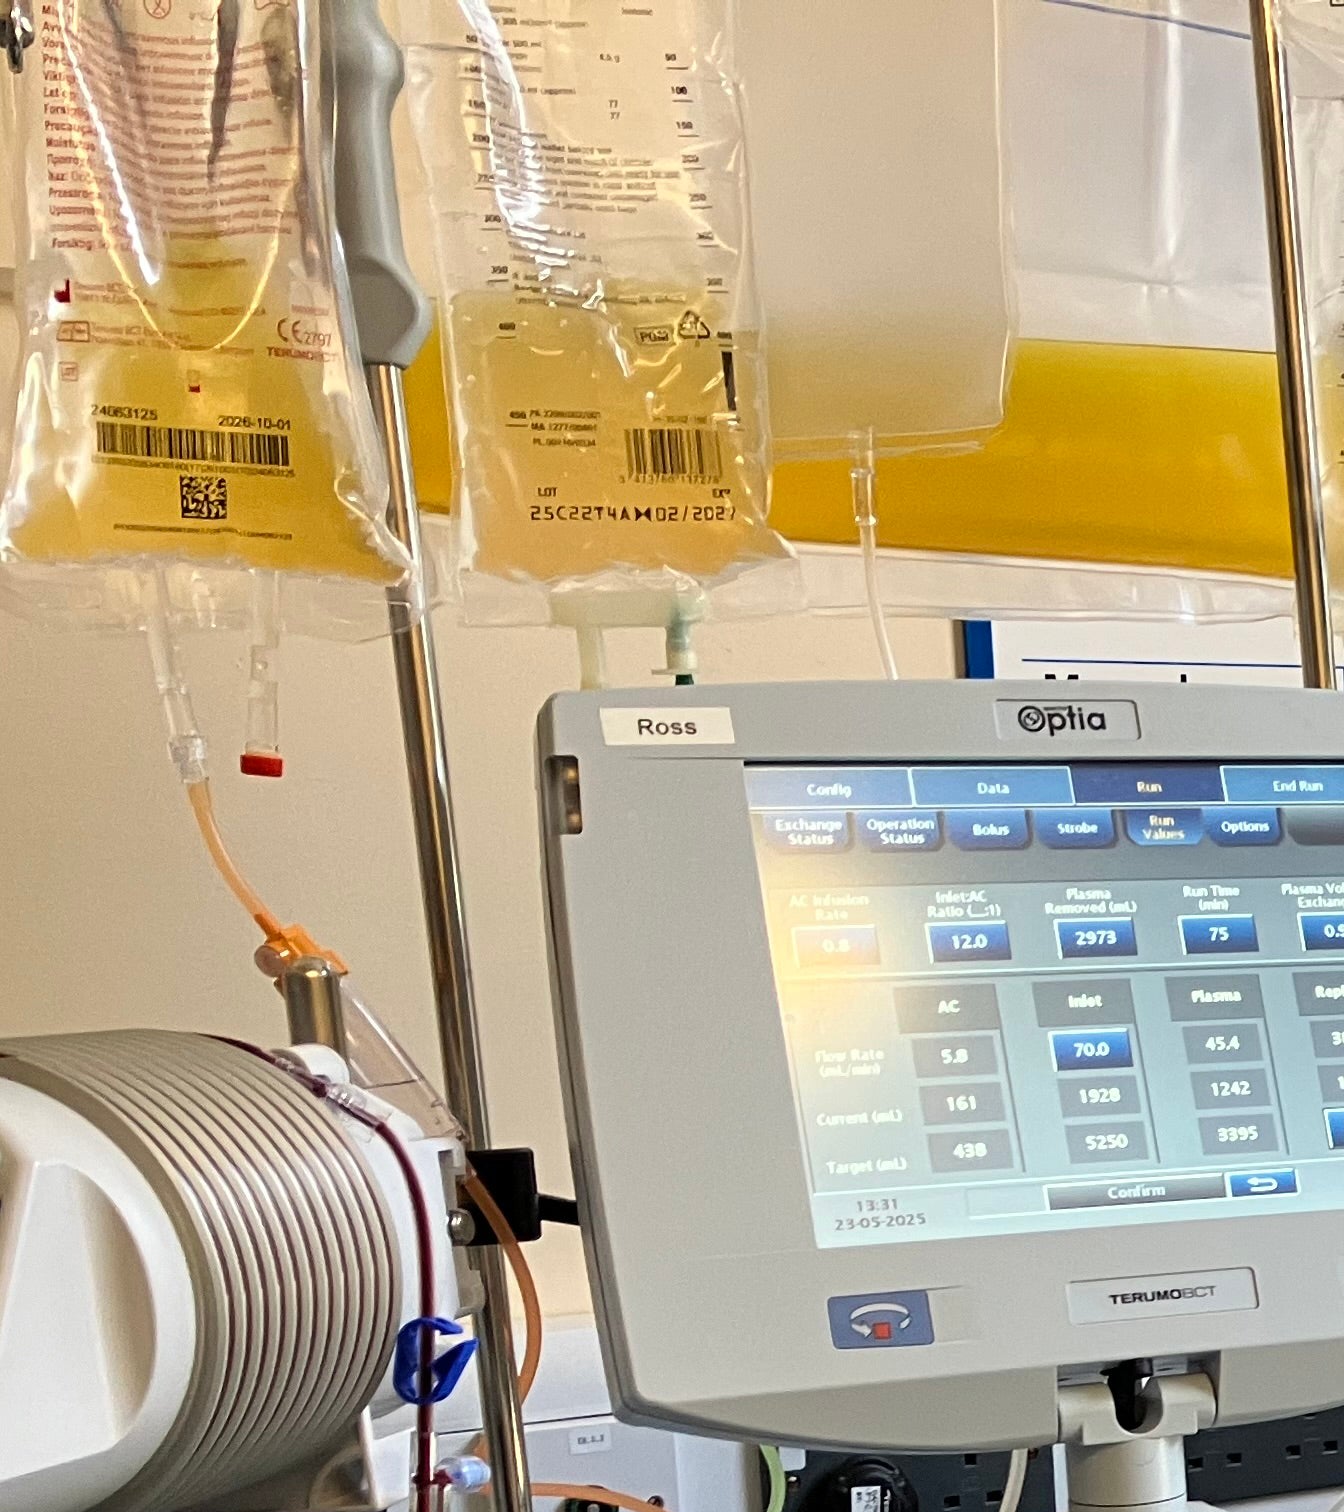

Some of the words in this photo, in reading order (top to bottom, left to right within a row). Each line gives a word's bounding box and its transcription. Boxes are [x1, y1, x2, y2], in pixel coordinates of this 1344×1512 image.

[303, 331, 332, 347] 2797
[217, 414, 292, 431] 2026-10-01
[537, 487, 558, 498] LOT
[637, 717, 698, 737] Ross
[1017, 705, 1107, 737] Optia
[807, 783, 852, 798] Config
[977, 782, 1010, 795] Data
[1137, 781, 1162, 793] Run
[1272, 780, 1296, 792] End
[1298, 780, 1324, 793] Run
[775, 818, 843, 833] Exchange
[866, 817, 935, 833] Operation
[1057, 822, 1099, 835] Strobe
[1149, 815, 1175, 827] Run
[1221, 820, 1270, 835] Options
[972, 823, 1010, 836] Bolus
[1142, 828, 1185, 841] Values
[787, 833, 834, 846] Status
[880, 832, 925, 845] Status
[1066, 888, 1111, 901] Plasma
[1183, 885, 1208, 898] Run
[1209, 885, 1240, 898] Time
[1281, 883, 1323, 897] Plasma
[927, 904, 964, 918] Ratio
[1045, 901, 1106, 914] Removed
[1198, 898, 1229, 912] (min)
[952, 934, 988, 949] 12.0
[1075, 930, 1117, 945] 2973
[1208, 927, 1229, 942] 75
[1067, 994, 1103, 1008] Inlet
[1191, 988, 1242, 1004] Plasma
[937, 1000, 961, 1014] AC
[1073, 1042, 1110, 1057] 70.0
[1205, 1035, 1240, 1051] 45.4
[941, 1048, 969, 1064] 5.8
[1210, 1080, 1251, 1096] 1242
[946, 1096, 977, 1111] 161
[1078, 1088, 1121, 1104] 1928
[816, 1113, 871, 1127] Current
[1217, 1126, 1259, 1142] 3395
[1085, 1134, 1129, 1151] 5250
[953, 1143, 988, 1159] 438
[826, 1160, 872, 1176] Target
[1108, 1184, 1166, 1199] Confirm
[856, 1198, 898, 1212] 13:31
[834, 1211, 927, 1232] 23-05-2025
